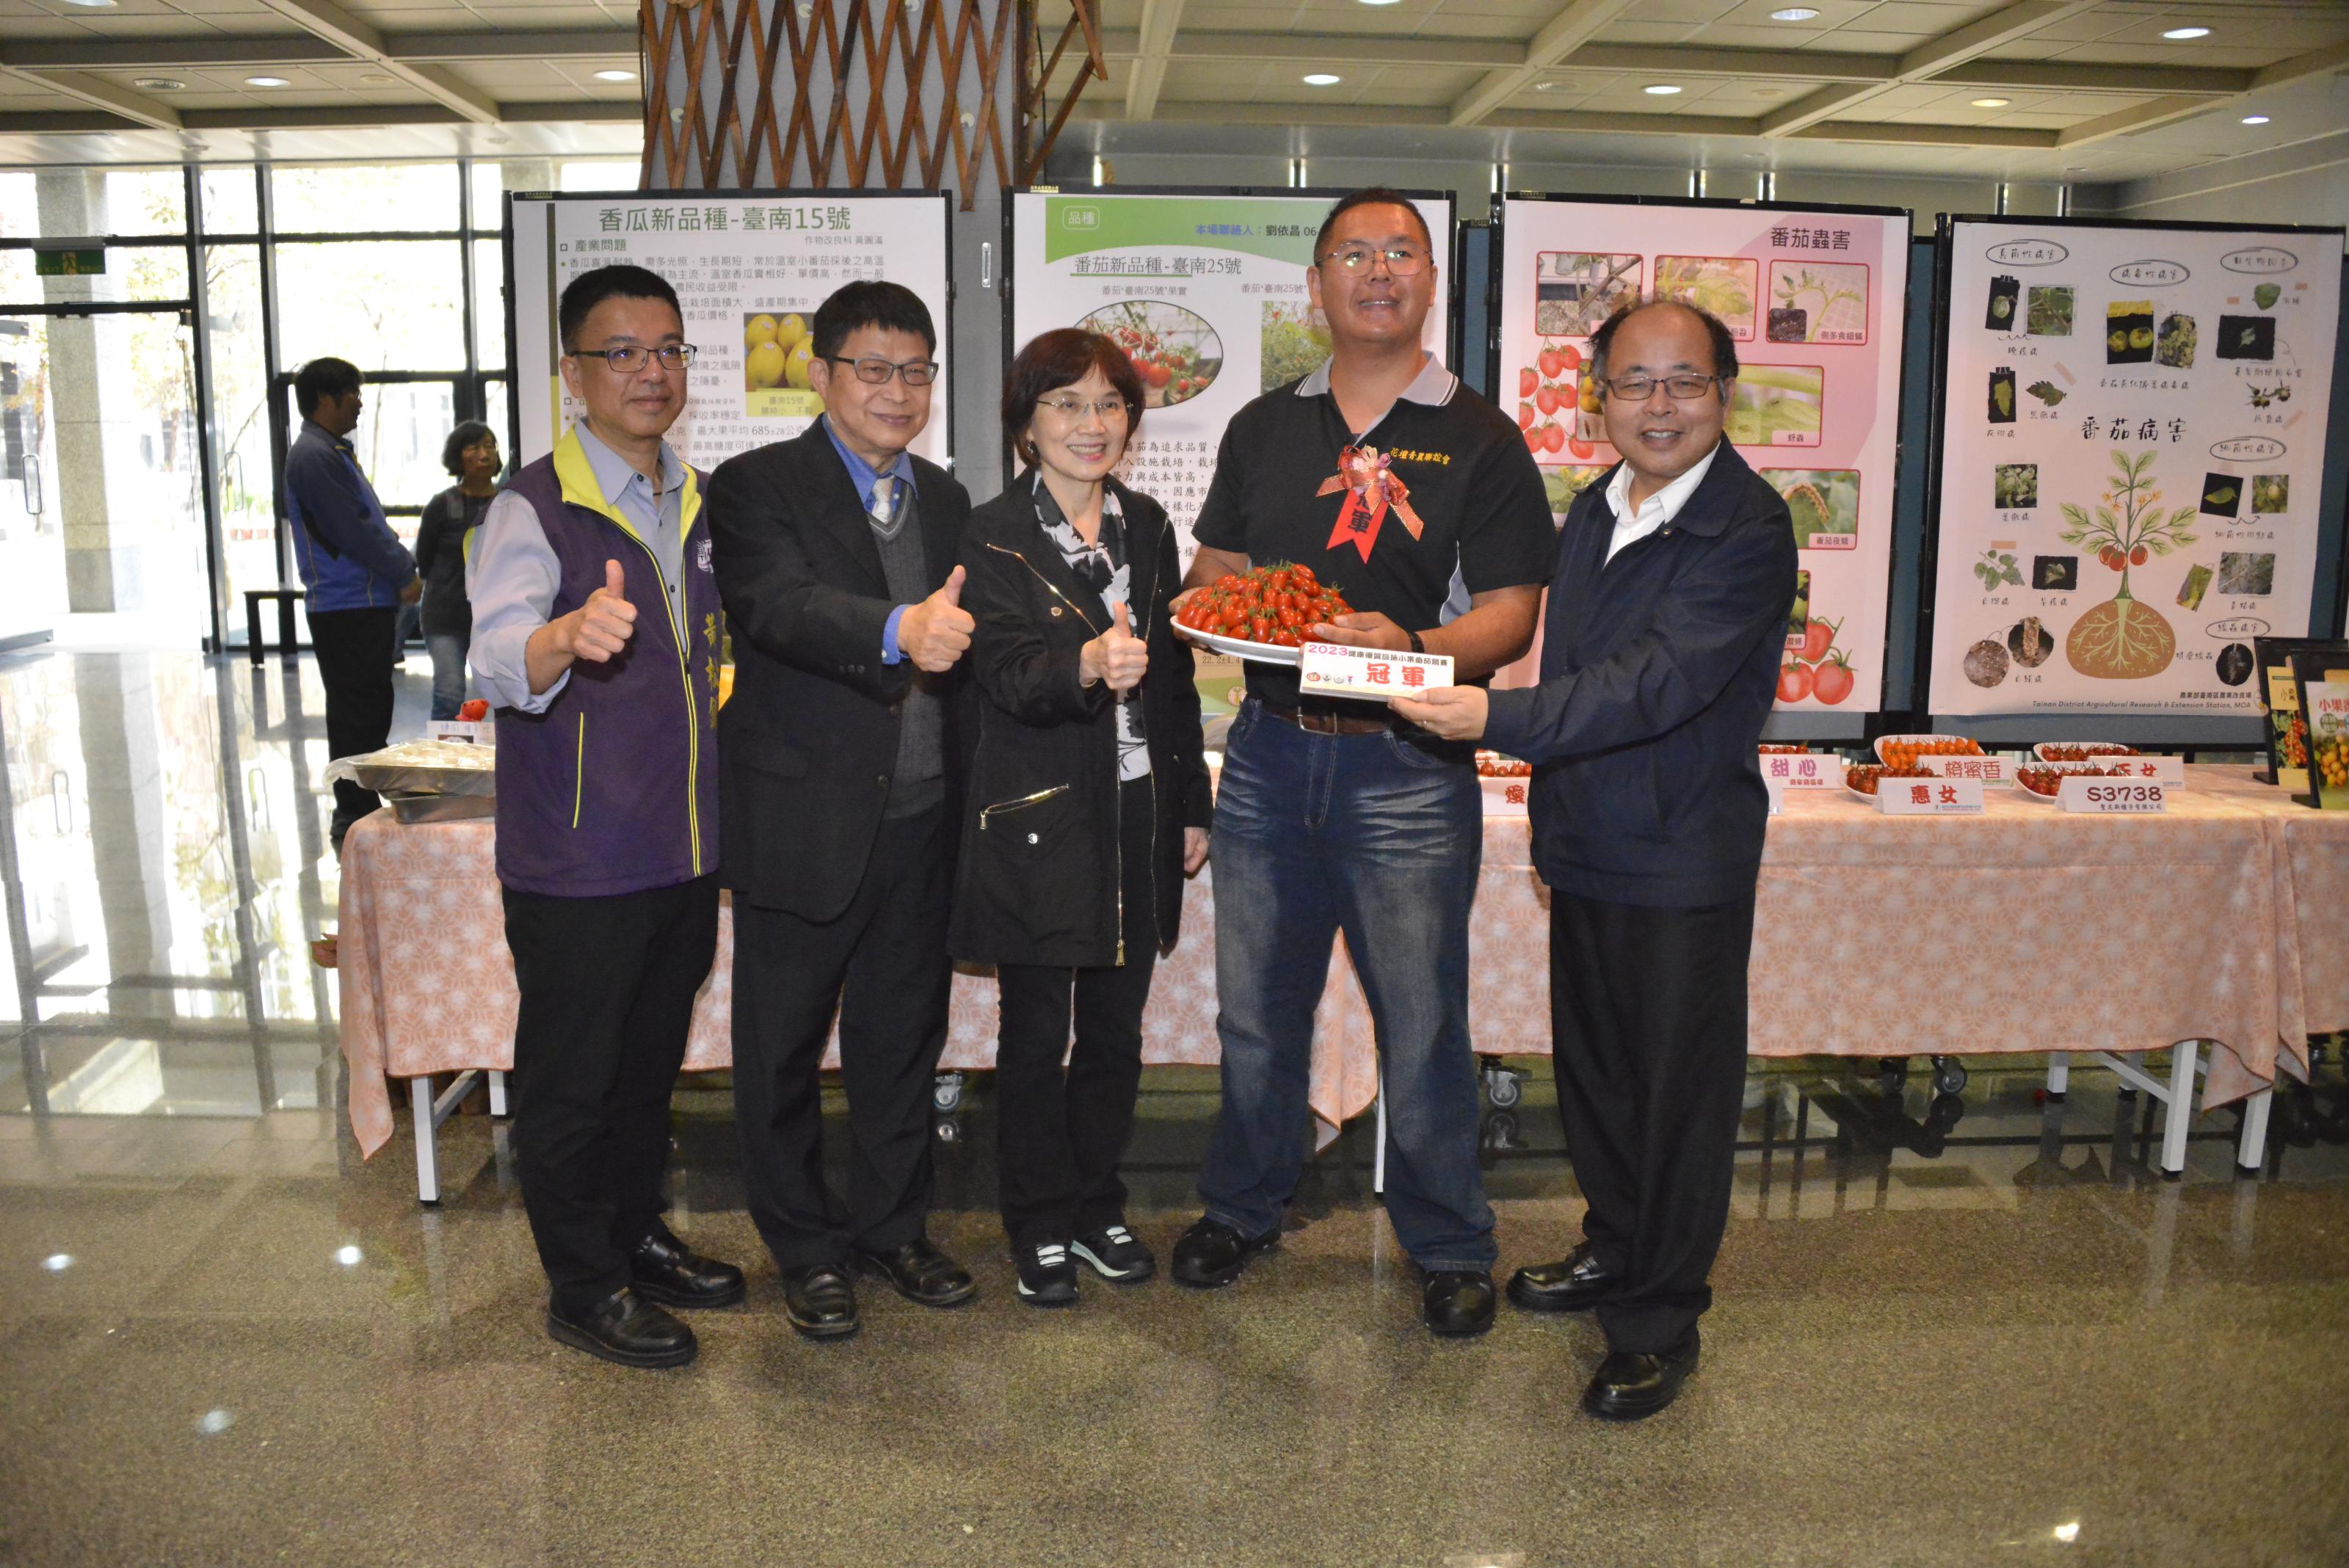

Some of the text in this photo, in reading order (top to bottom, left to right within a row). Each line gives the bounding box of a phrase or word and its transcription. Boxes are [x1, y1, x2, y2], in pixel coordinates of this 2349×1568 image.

[599, 206, 851, 231] 香瓜新品種-臺南15號
[1068, 211, 1095, 225] 品種
[575, 239, 626, 252] 產業問題
[1771, 226, 1851, 250] 番茄蟲害
[1074, 255, 1242, 275] 番茄新品種-臺南25號
[1820, 331, 1863, 341] 側多食細蟎
[2080, 416, 2187, 443] 番茄病害
[1365, 662, 1426, 688] 冠軍
[1770, 758, 1817, 777] 甜心
[1945, 761, 2001, 779] 橙蜜香
[1505, 784, 1526, 805] 愛
[1910, 785, 1958, 805] 惠女
[2087, 786, 2163, 802] S3738
